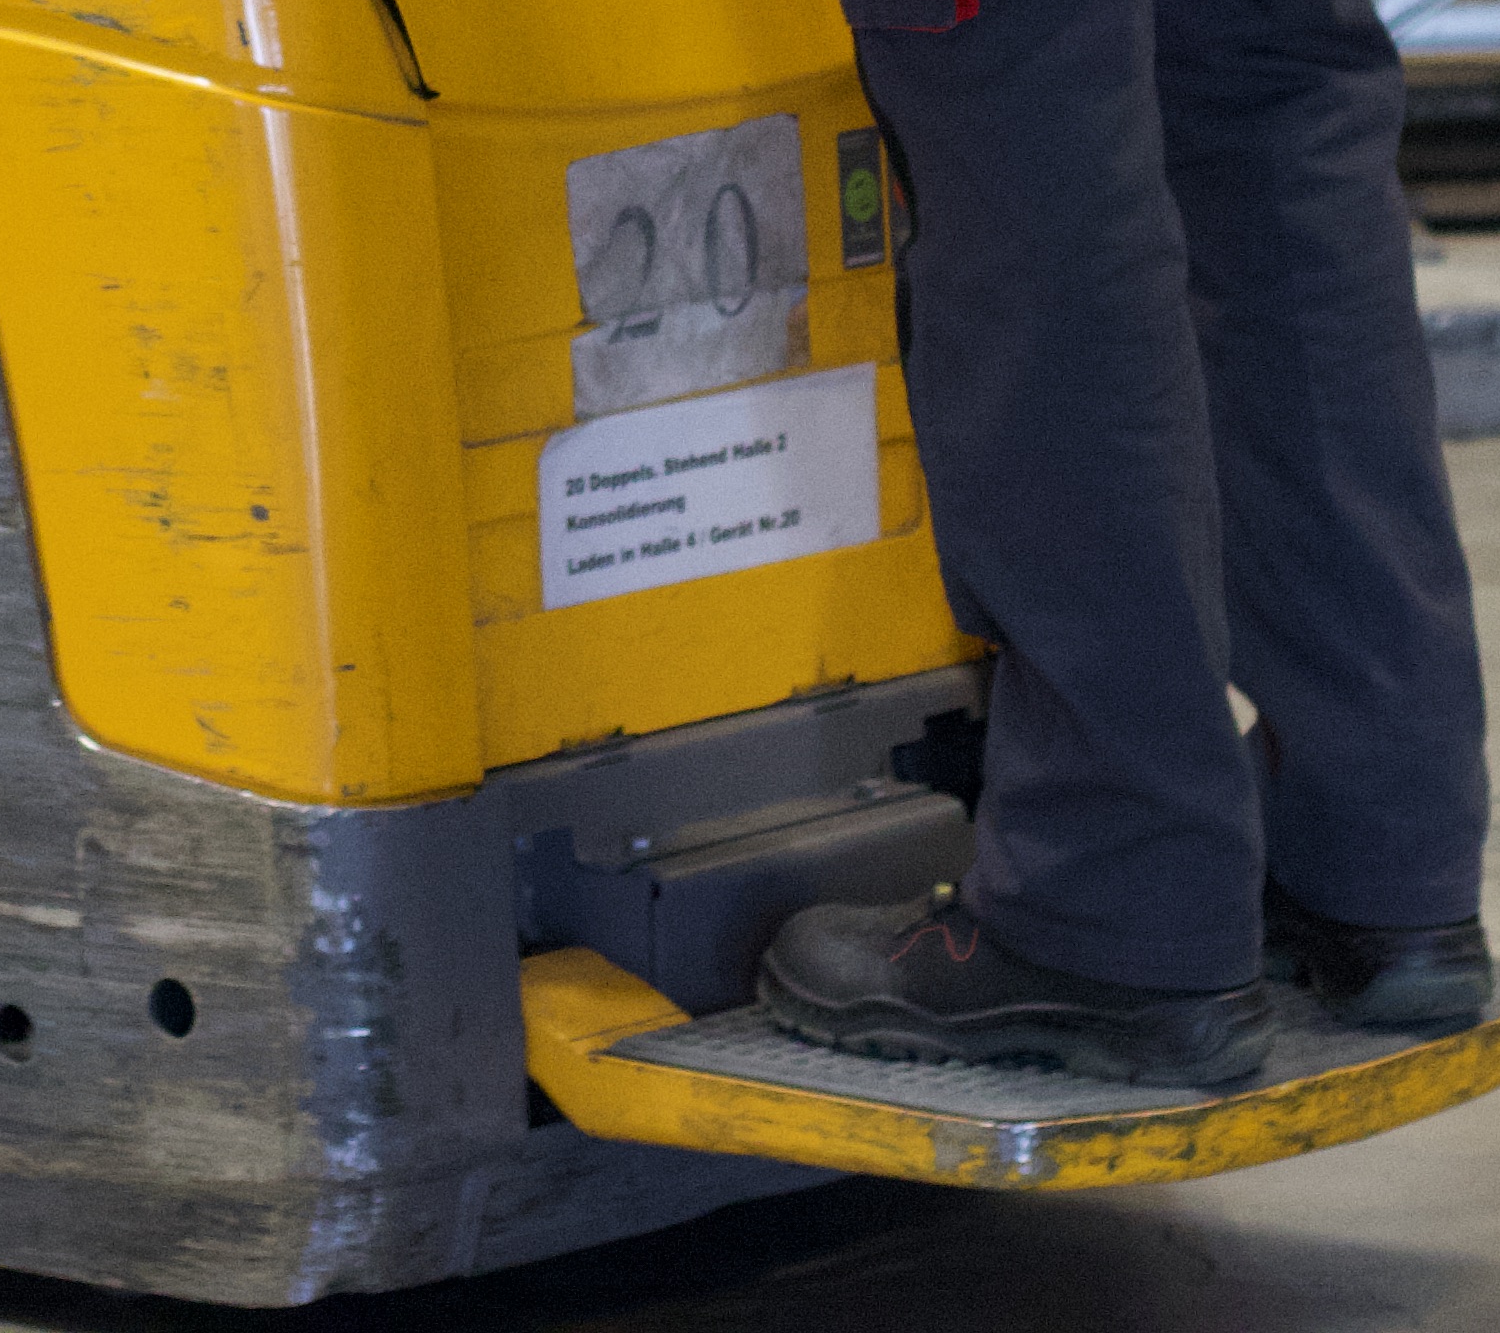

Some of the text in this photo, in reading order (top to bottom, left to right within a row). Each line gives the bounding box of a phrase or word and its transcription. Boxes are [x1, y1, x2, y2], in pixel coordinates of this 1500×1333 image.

[606, 182, 758, 345] 20
[565, 475, 585, 497] 20
[664, 448, 727, 475] Stehend
[733, 438, 773, 459] Halle
[778, 433, 788, 452] 2
[566, 494, 687, 532] Konsolidierung
[567, 553, 615, 576] Laden
[621, 549, 635, 563] in
[641, 539, 682, 558] Halle
[710, 521, 753, 544] Gerät
